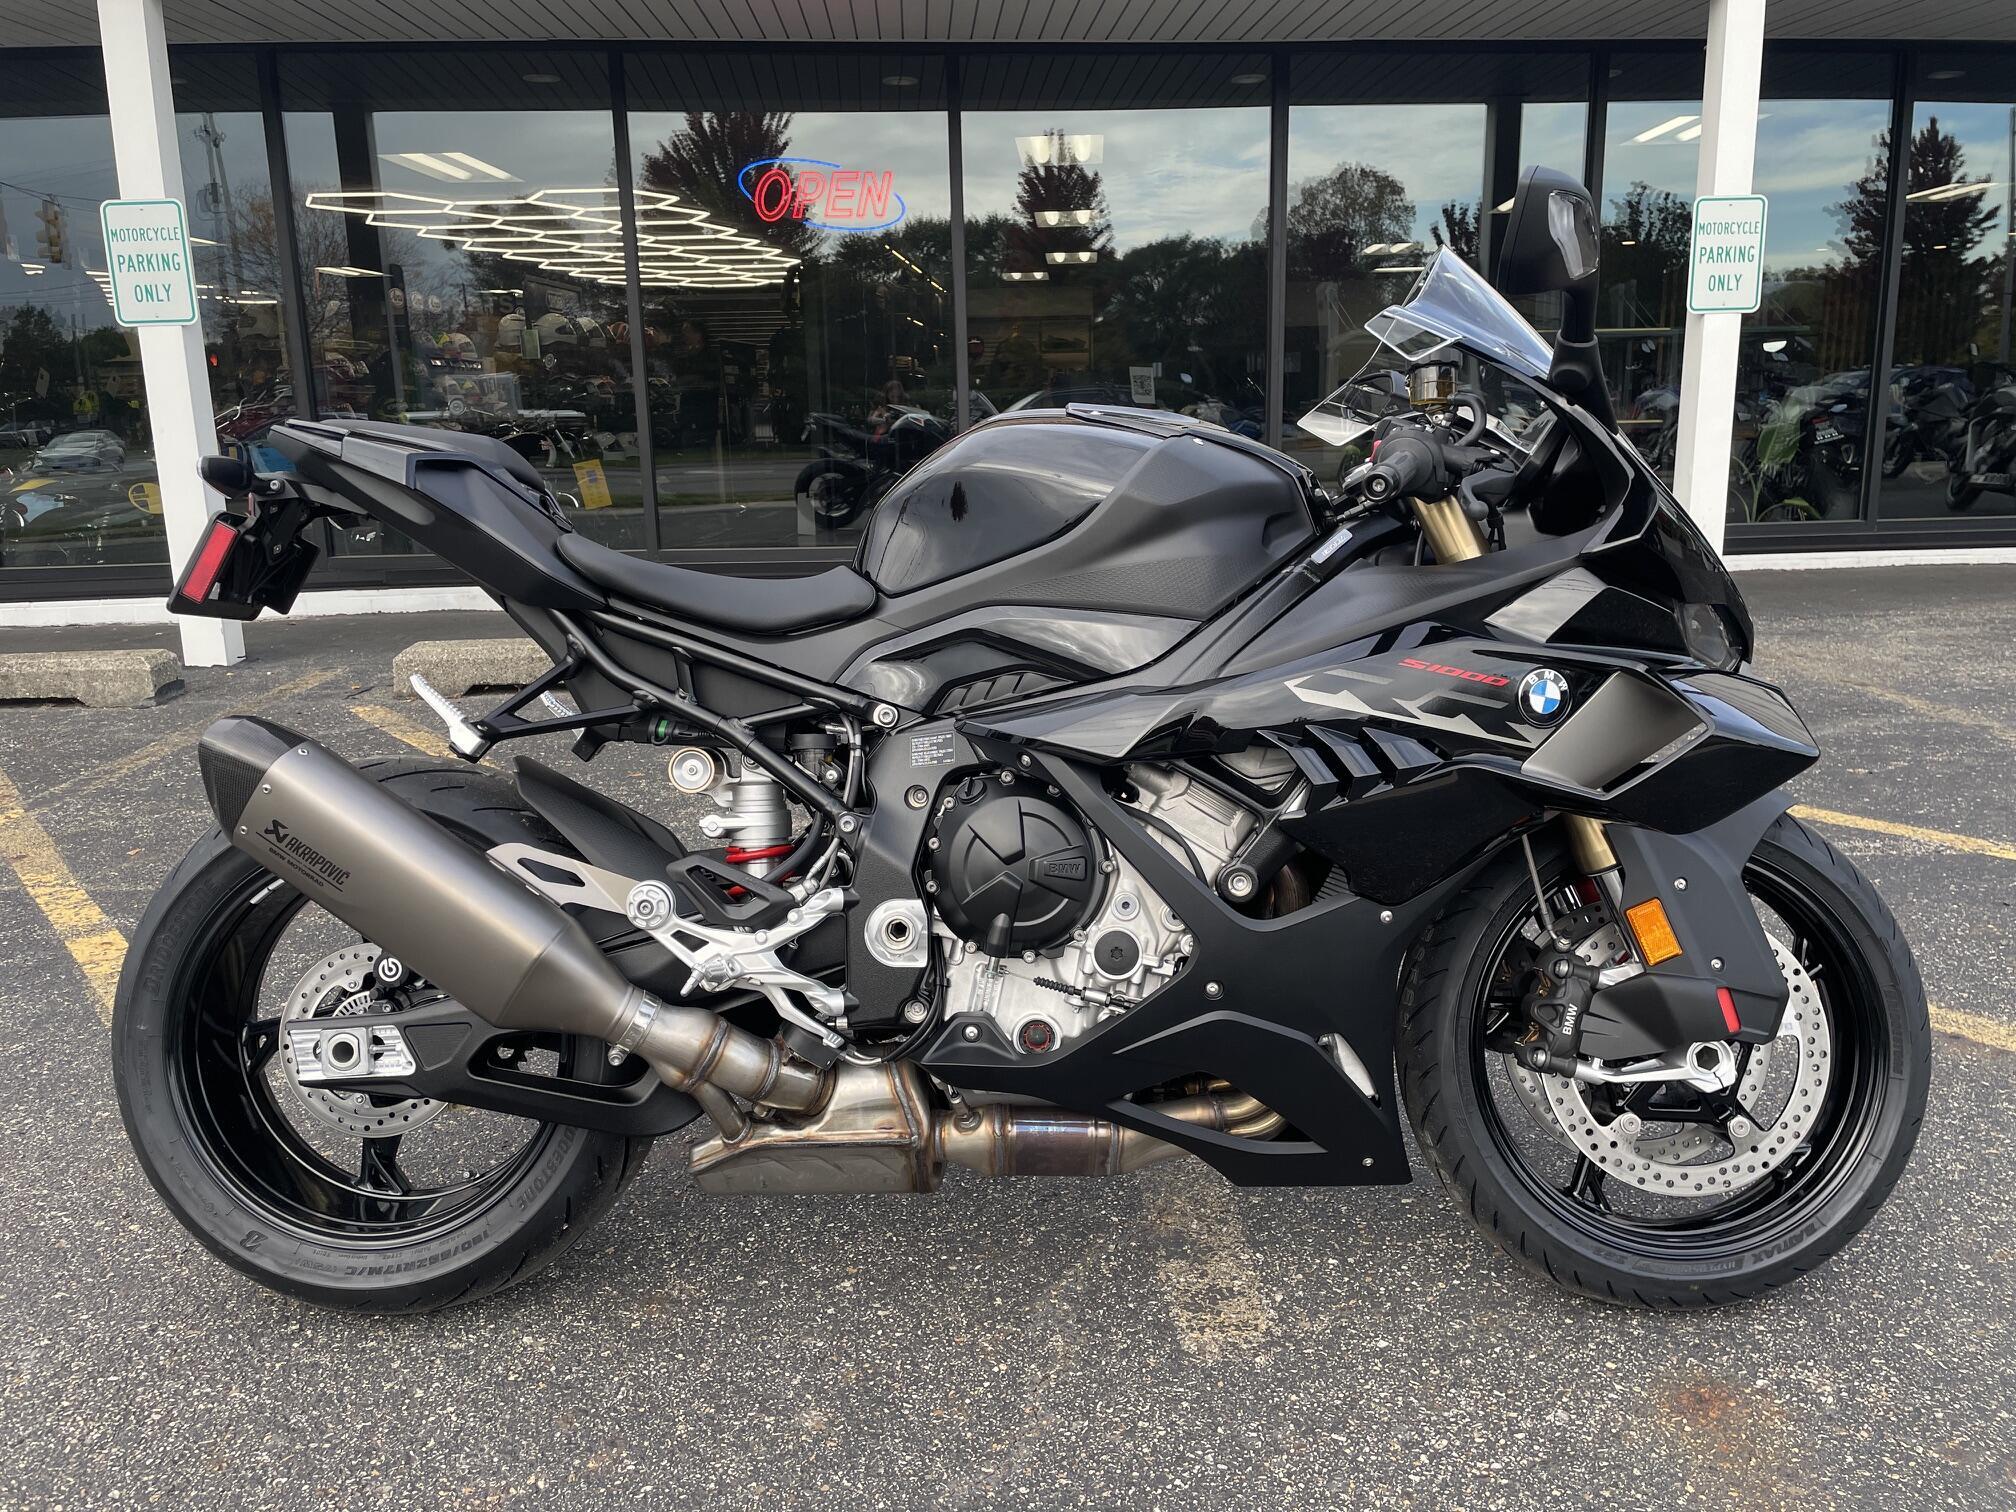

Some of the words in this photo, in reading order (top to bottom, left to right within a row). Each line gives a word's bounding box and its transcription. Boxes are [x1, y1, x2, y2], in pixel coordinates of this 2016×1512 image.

[754, 168, 895, 222] OPEN
[110, 226, 181, 243] MOTORCYCLE
[1698, 221, 1760, 236] MOTORCYCLE
[117, 252, 181, 273] PARKING
[1698, 245, 1755, 265] PARKING
[134, 283, 172, 304] ONLY
[1708, 273, 1742, 293] ONLY
[1397, 657, 1511, 688] S1000
[1527, 670, 1569, 692] BMW
[286, 859, 325, 888] MOTORRAD
[1049, 863, 1081, 874] BMW
[1562, 1003, 1578, 1036] BMW
